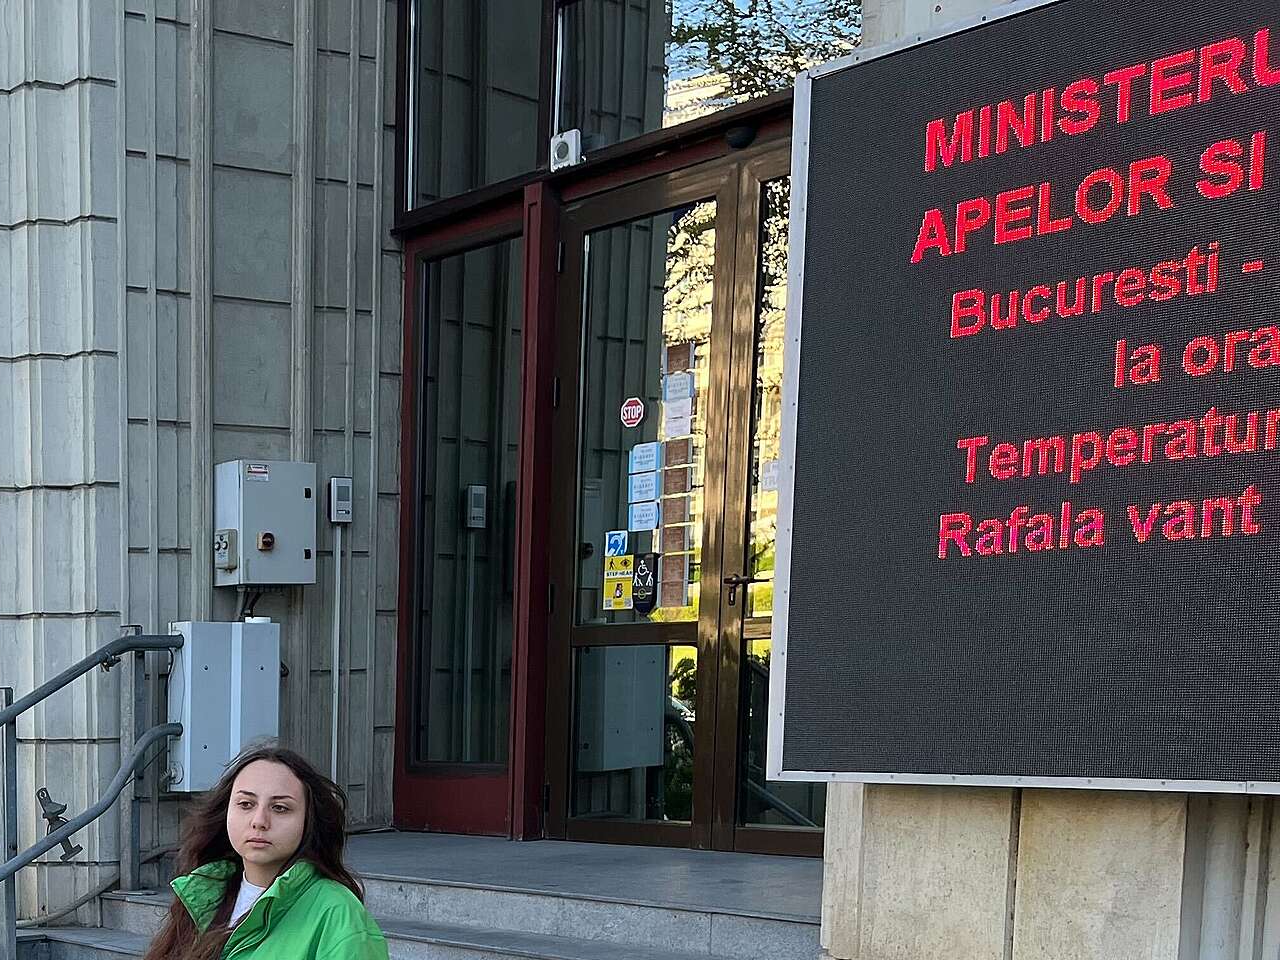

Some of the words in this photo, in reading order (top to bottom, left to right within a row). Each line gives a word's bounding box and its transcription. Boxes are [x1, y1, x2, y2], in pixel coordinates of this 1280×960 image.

[910, 155, 1175, 264] APELOR
[1195, 131, 1267, 199] SI
[950, 241, 1221, 338] Bucuresti
[1114, 338, 1162, 388] la
[1182, 325, 1280, 376] ora
[623, 405, 641, 420] STOP
[937, 500, 1105, 559] Rafala
[1126, 484, 1263, 543] vant
